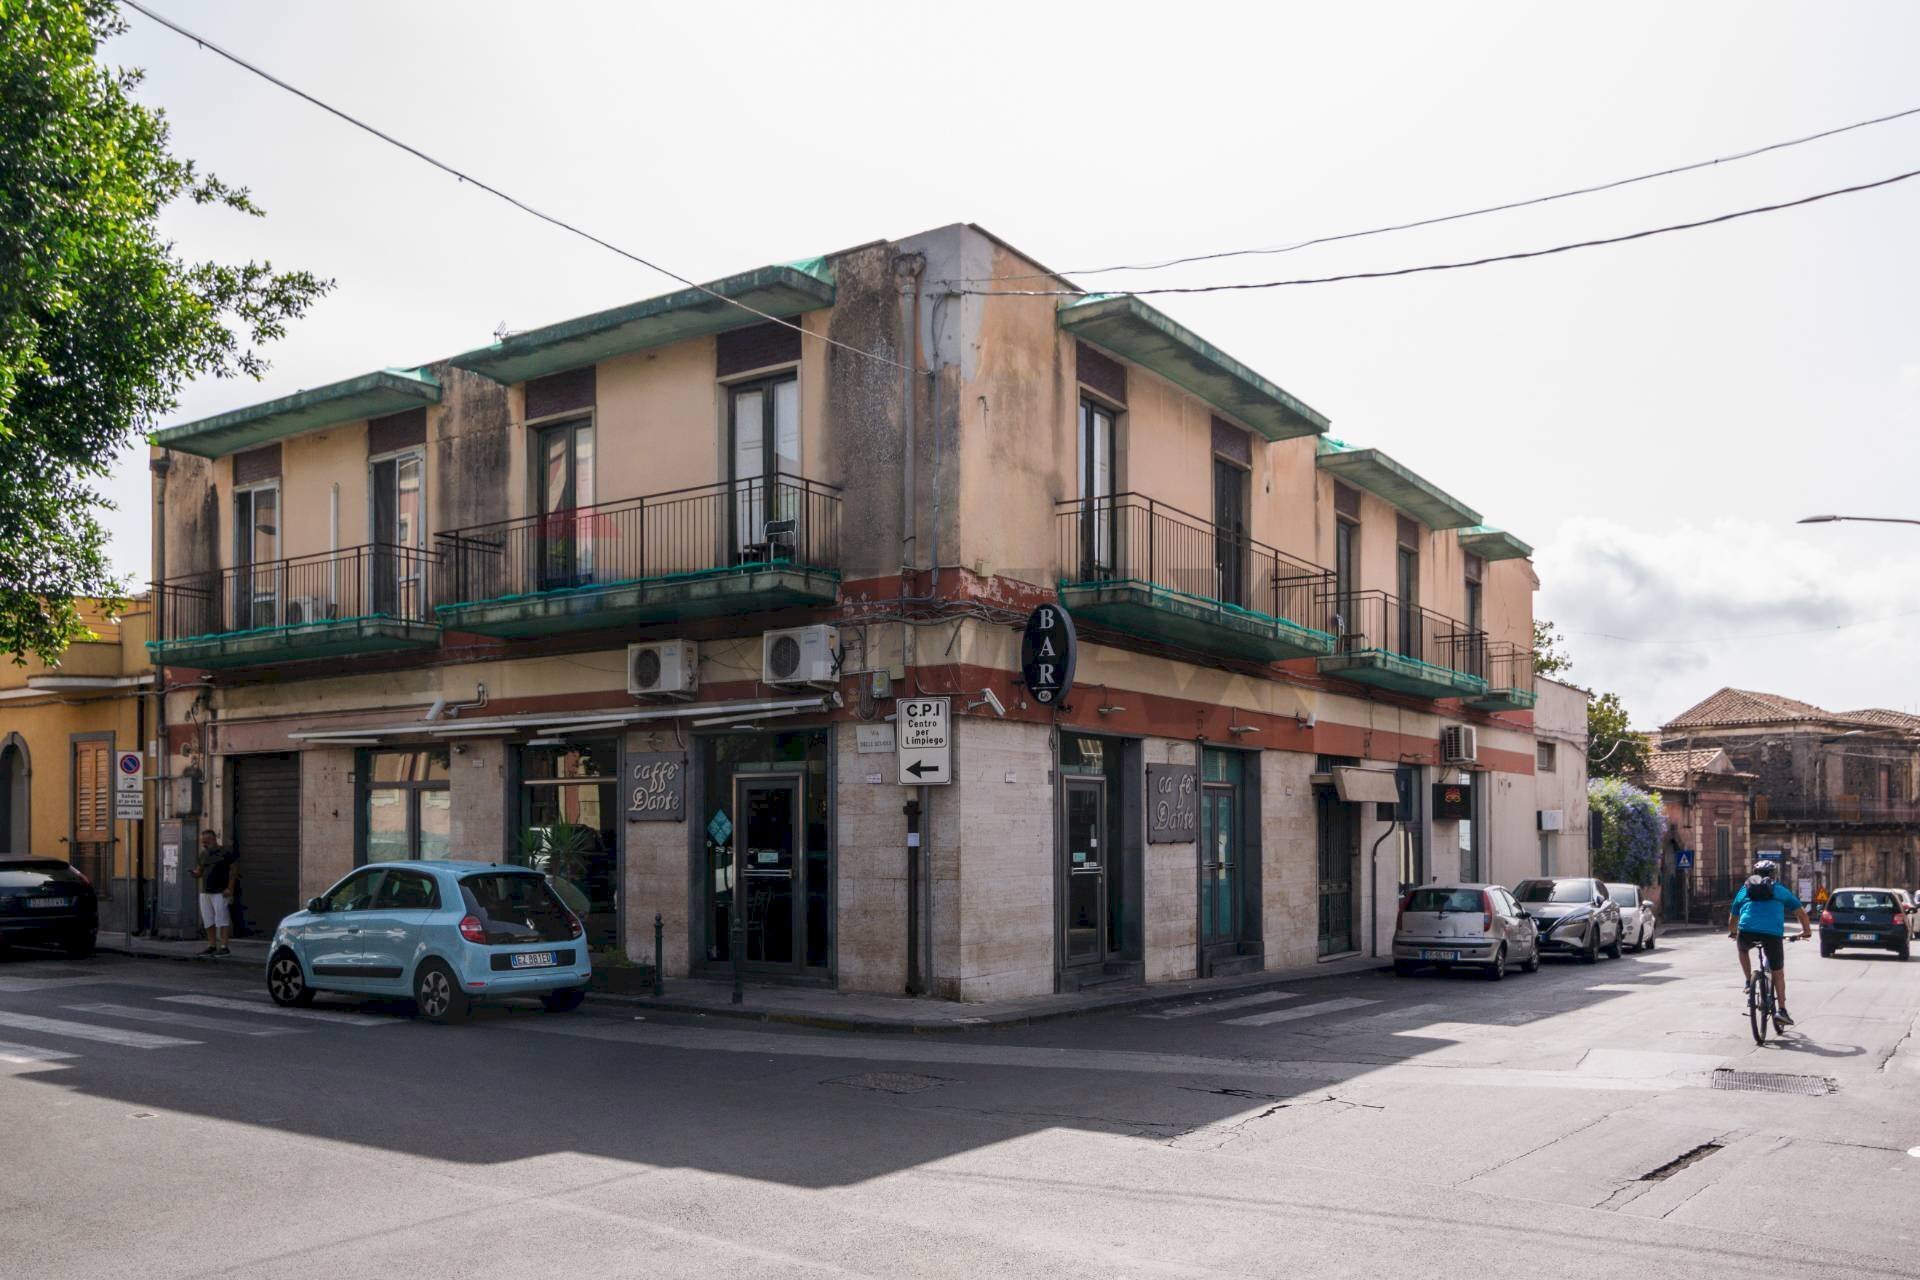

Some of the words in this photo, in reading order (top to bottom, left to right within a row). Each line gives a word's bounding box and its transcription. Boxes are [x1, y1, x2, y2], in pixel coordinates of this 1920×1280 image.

[1040, 608, 1056, 684] BAR
[906, 703, 940, 717] C.P.I
[908, 719, 937, 728] Centro
[915, 729, 929, 737] per
[627, 786, 680, 812] Dante
[1153, 800, 1194, 831] Dante
